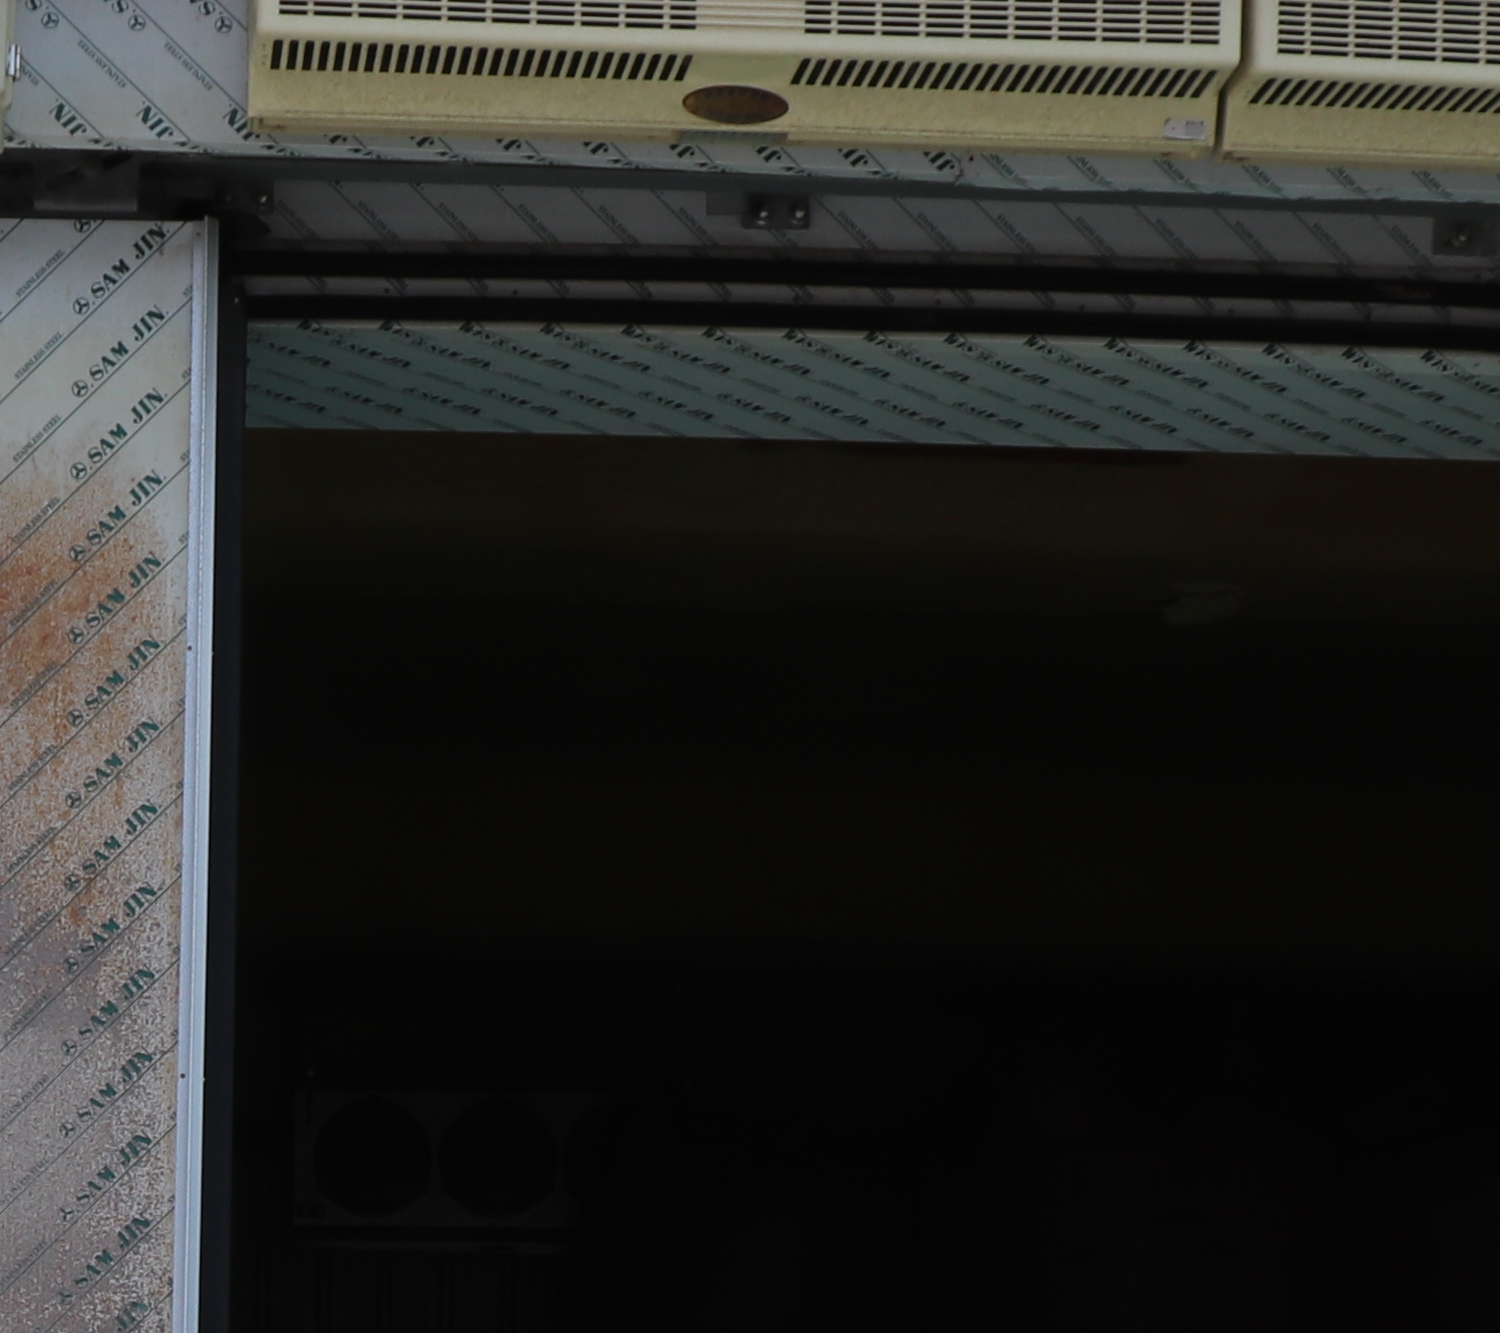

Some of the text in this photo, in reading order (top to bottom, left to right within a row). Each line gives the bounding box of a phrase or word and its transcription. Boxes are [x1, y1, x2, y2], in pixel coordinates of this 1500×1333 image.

[89, 257, 130, 300] SAM
[88, 339, 129, 382] SAM
[87, 421, 128, 464] SAM
[86, 504, 127, 547] SAM
[81, 833, 122, 876] SAM
